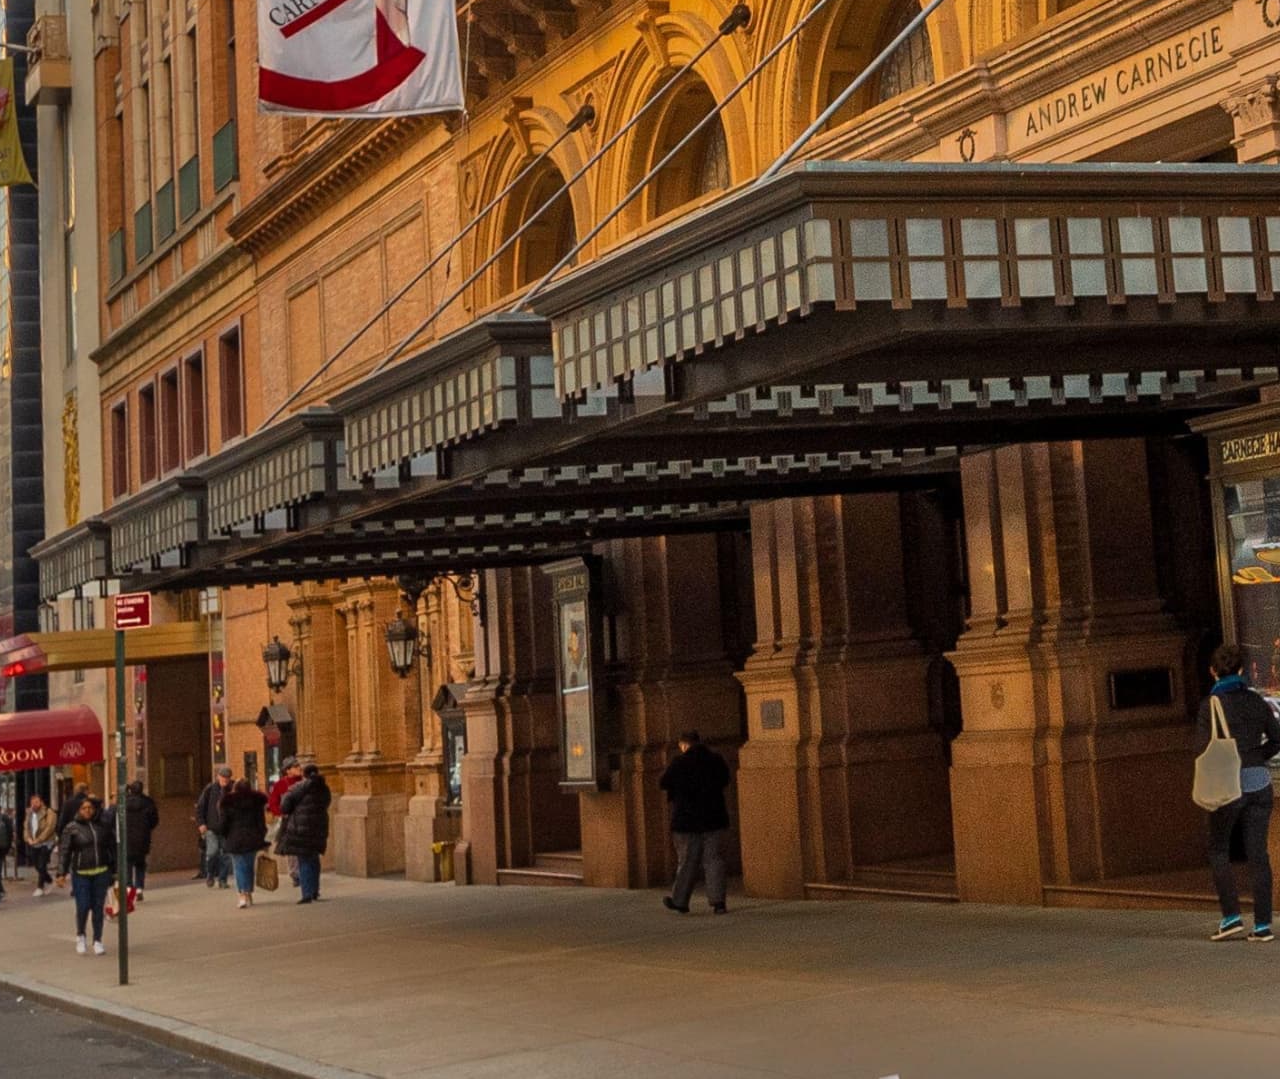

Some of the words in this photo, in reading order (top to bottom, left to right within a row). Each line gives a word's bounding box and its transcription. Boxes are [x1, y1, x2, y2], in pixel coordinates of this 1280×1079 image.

[1026, 76, 1109, 137] ANDREW
[1115, 25, 1224, 96] CARNEGIE
[1222, 437, 1266, 460] CARNEGIE
